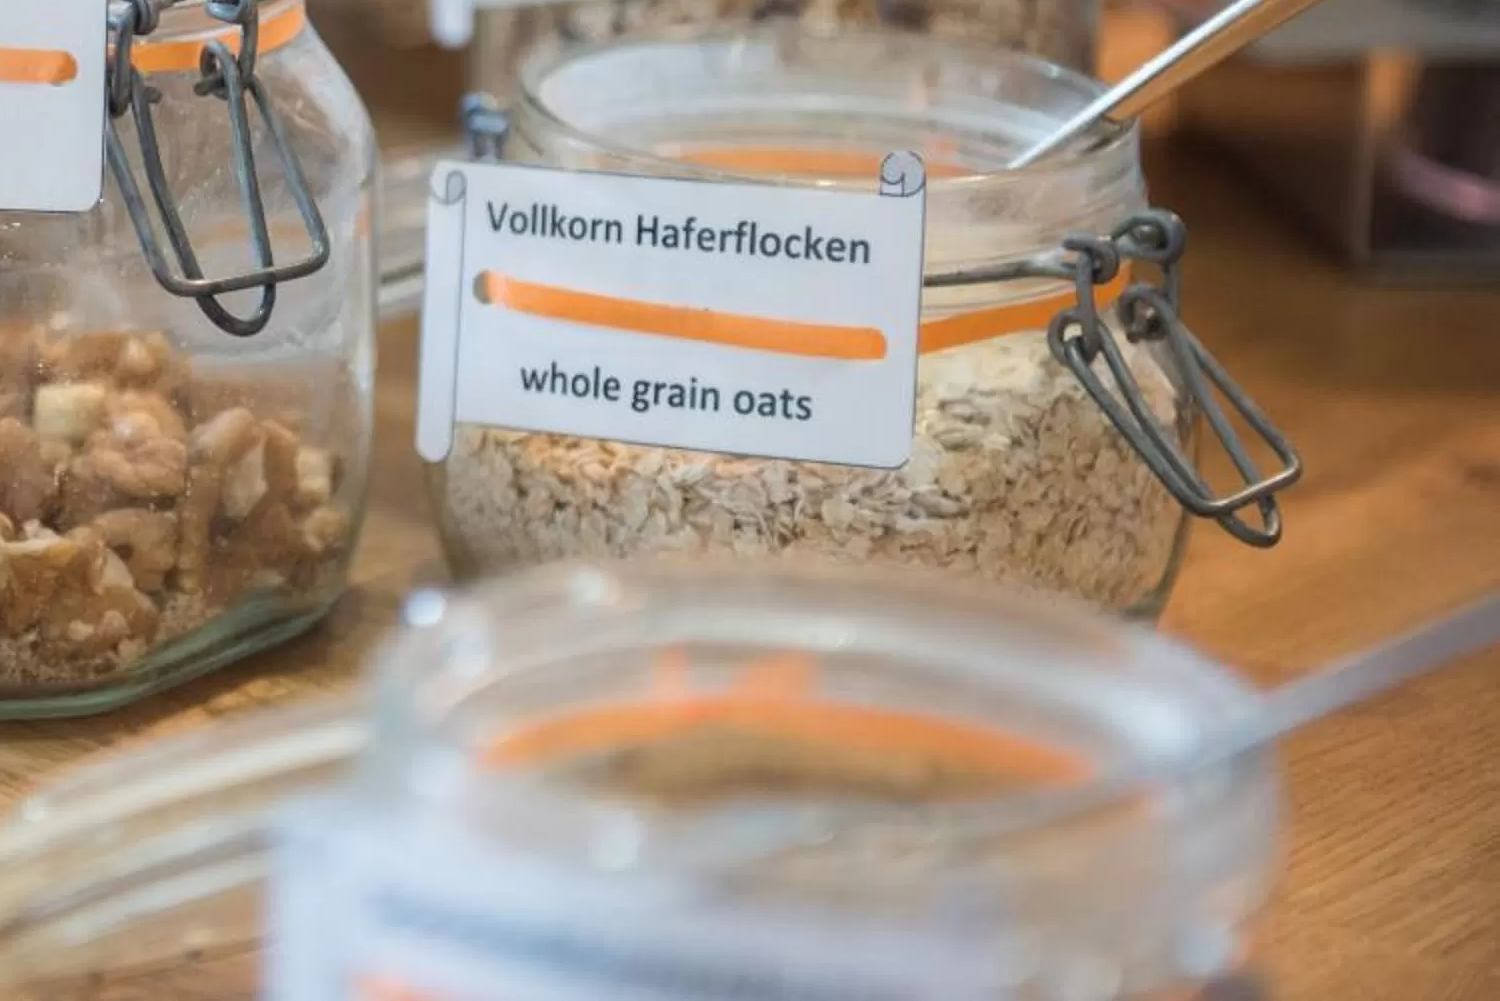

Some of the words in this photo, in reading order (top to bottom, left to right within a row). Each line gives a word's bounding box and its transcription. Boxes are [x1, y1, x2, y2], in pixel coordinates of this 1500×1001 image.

[486, 201, 623, 244] Vollkorn
[635, 214, 871, 264] Haferflocken
[520, 361, 622, 401] whole
[631, 375, 721, 412] grain
[733, 387, 812, 421] oats
